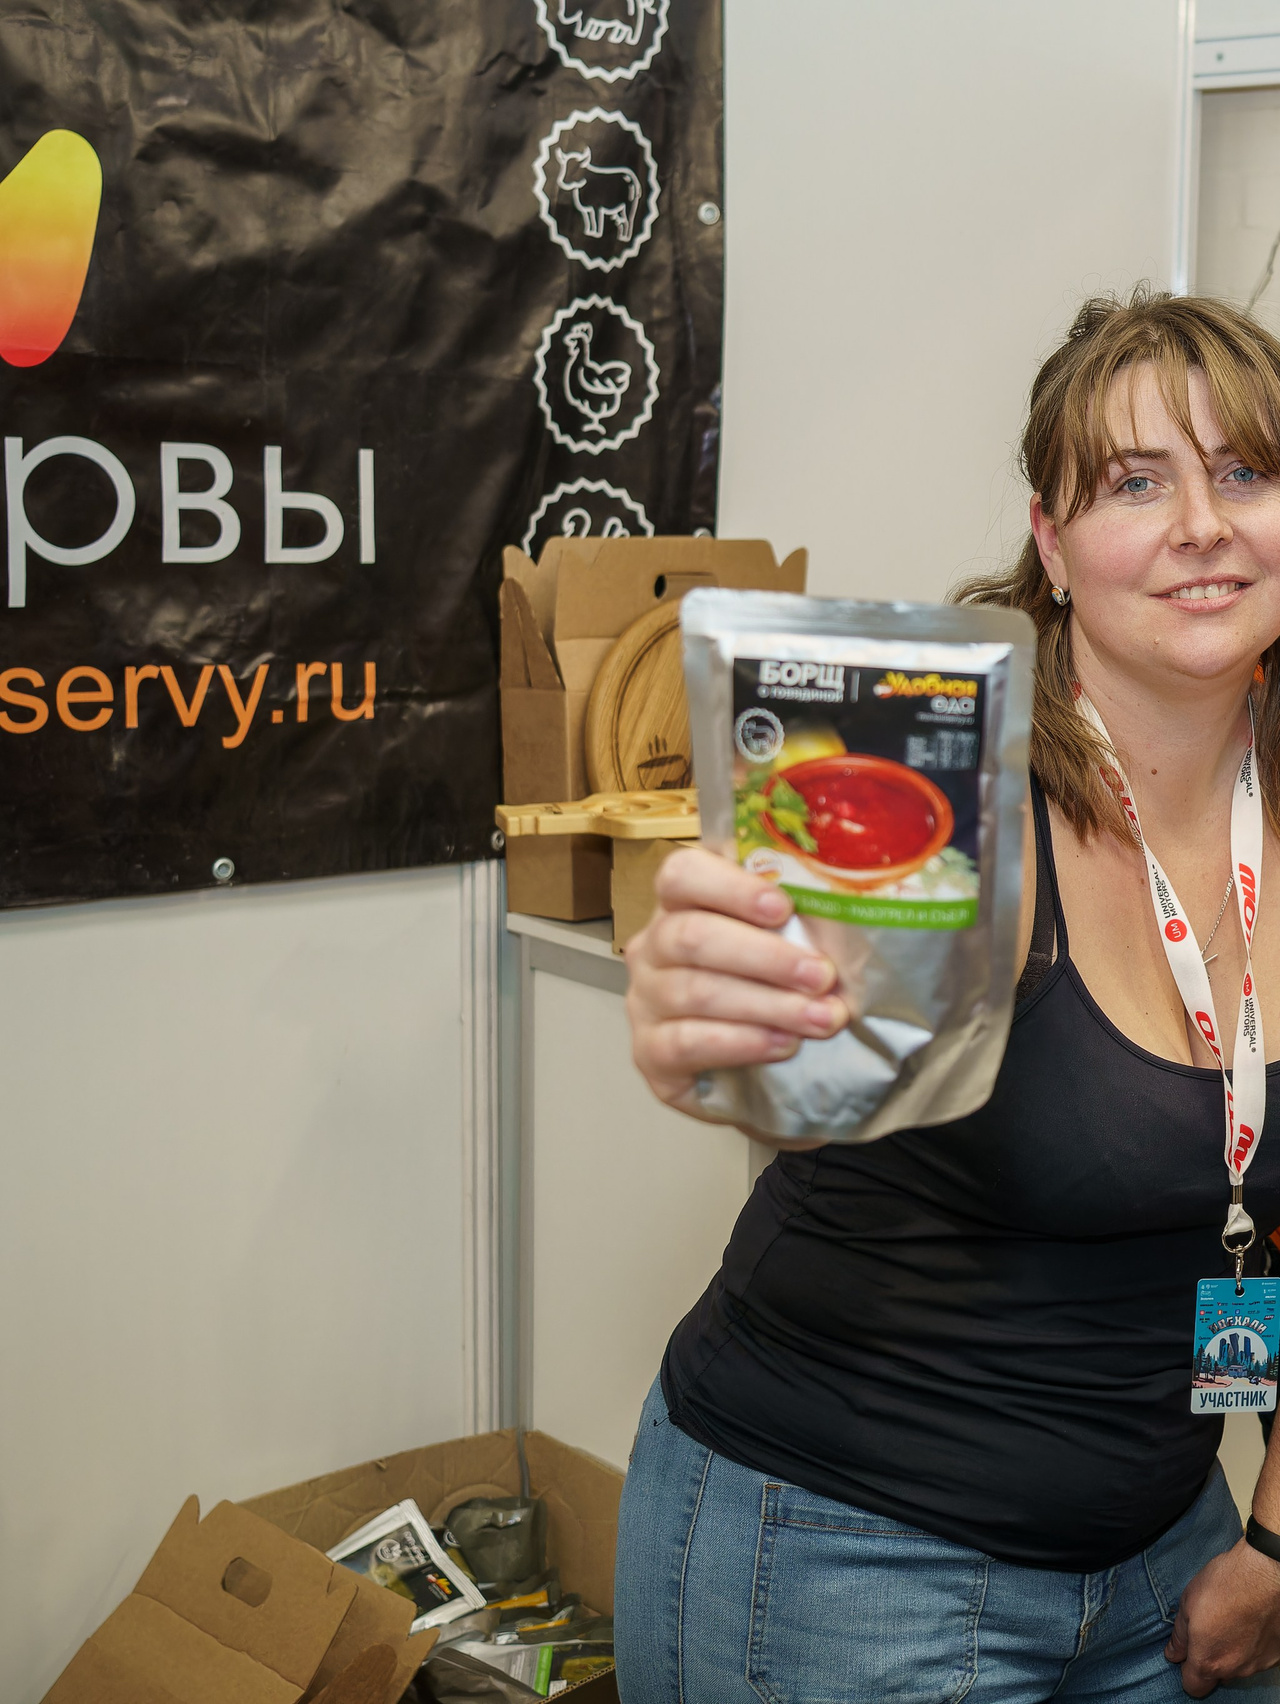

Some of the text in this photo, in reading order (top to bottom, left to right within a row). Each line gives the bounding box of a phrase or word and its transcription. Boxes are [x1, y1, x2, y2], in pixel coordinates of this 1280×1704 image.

[4, 435, 376, 608] рвы
[758, 661, 845, 690] БОРЩ
[0, 661, 377, 749] servy.ru
[1208, 1315, 1268, 1334] ПОЕХАЛИ
[1200, 1390, 1267, 1408] УЧАСТНИК
